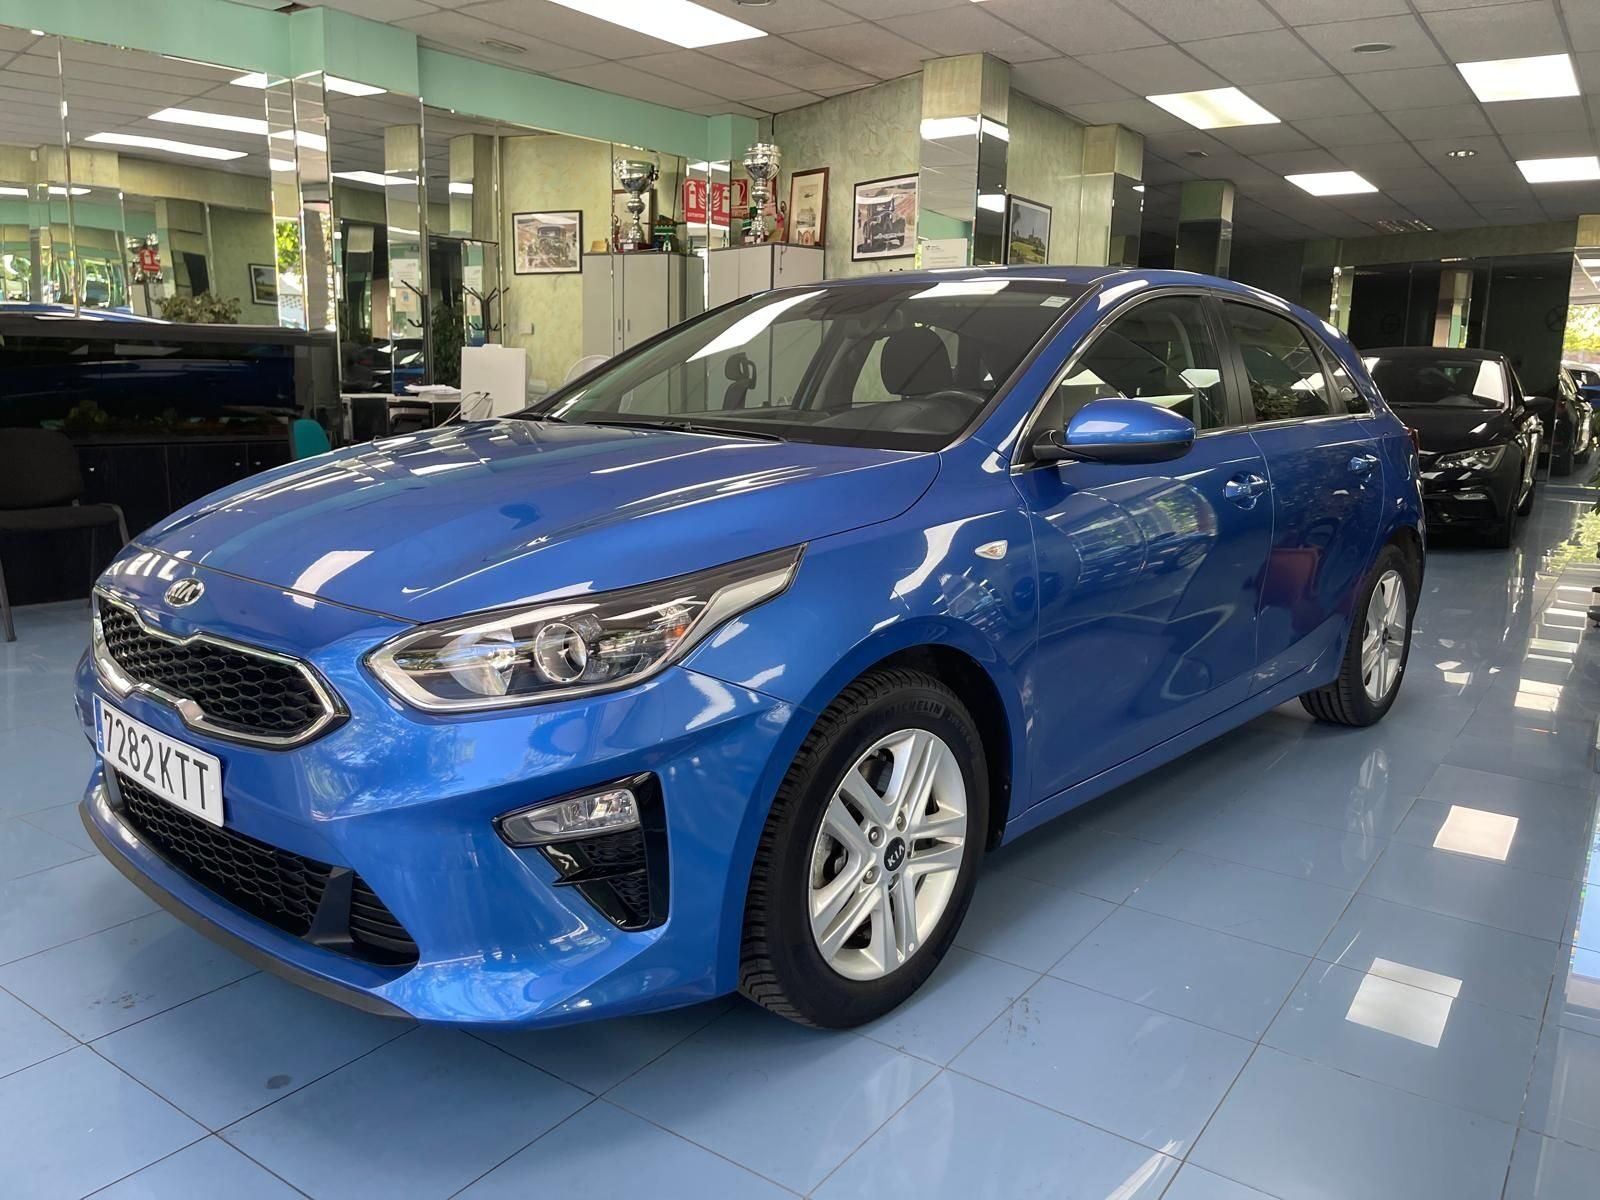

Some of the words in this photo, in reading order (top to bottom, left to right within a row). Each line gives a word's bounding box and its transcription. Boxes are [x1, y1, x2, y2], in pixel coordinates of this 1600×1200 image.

[169, 580, 197, 601] KIA
[104, 709, 209, 810] 7282KTT
[887, 844, 905, 867] KIA
